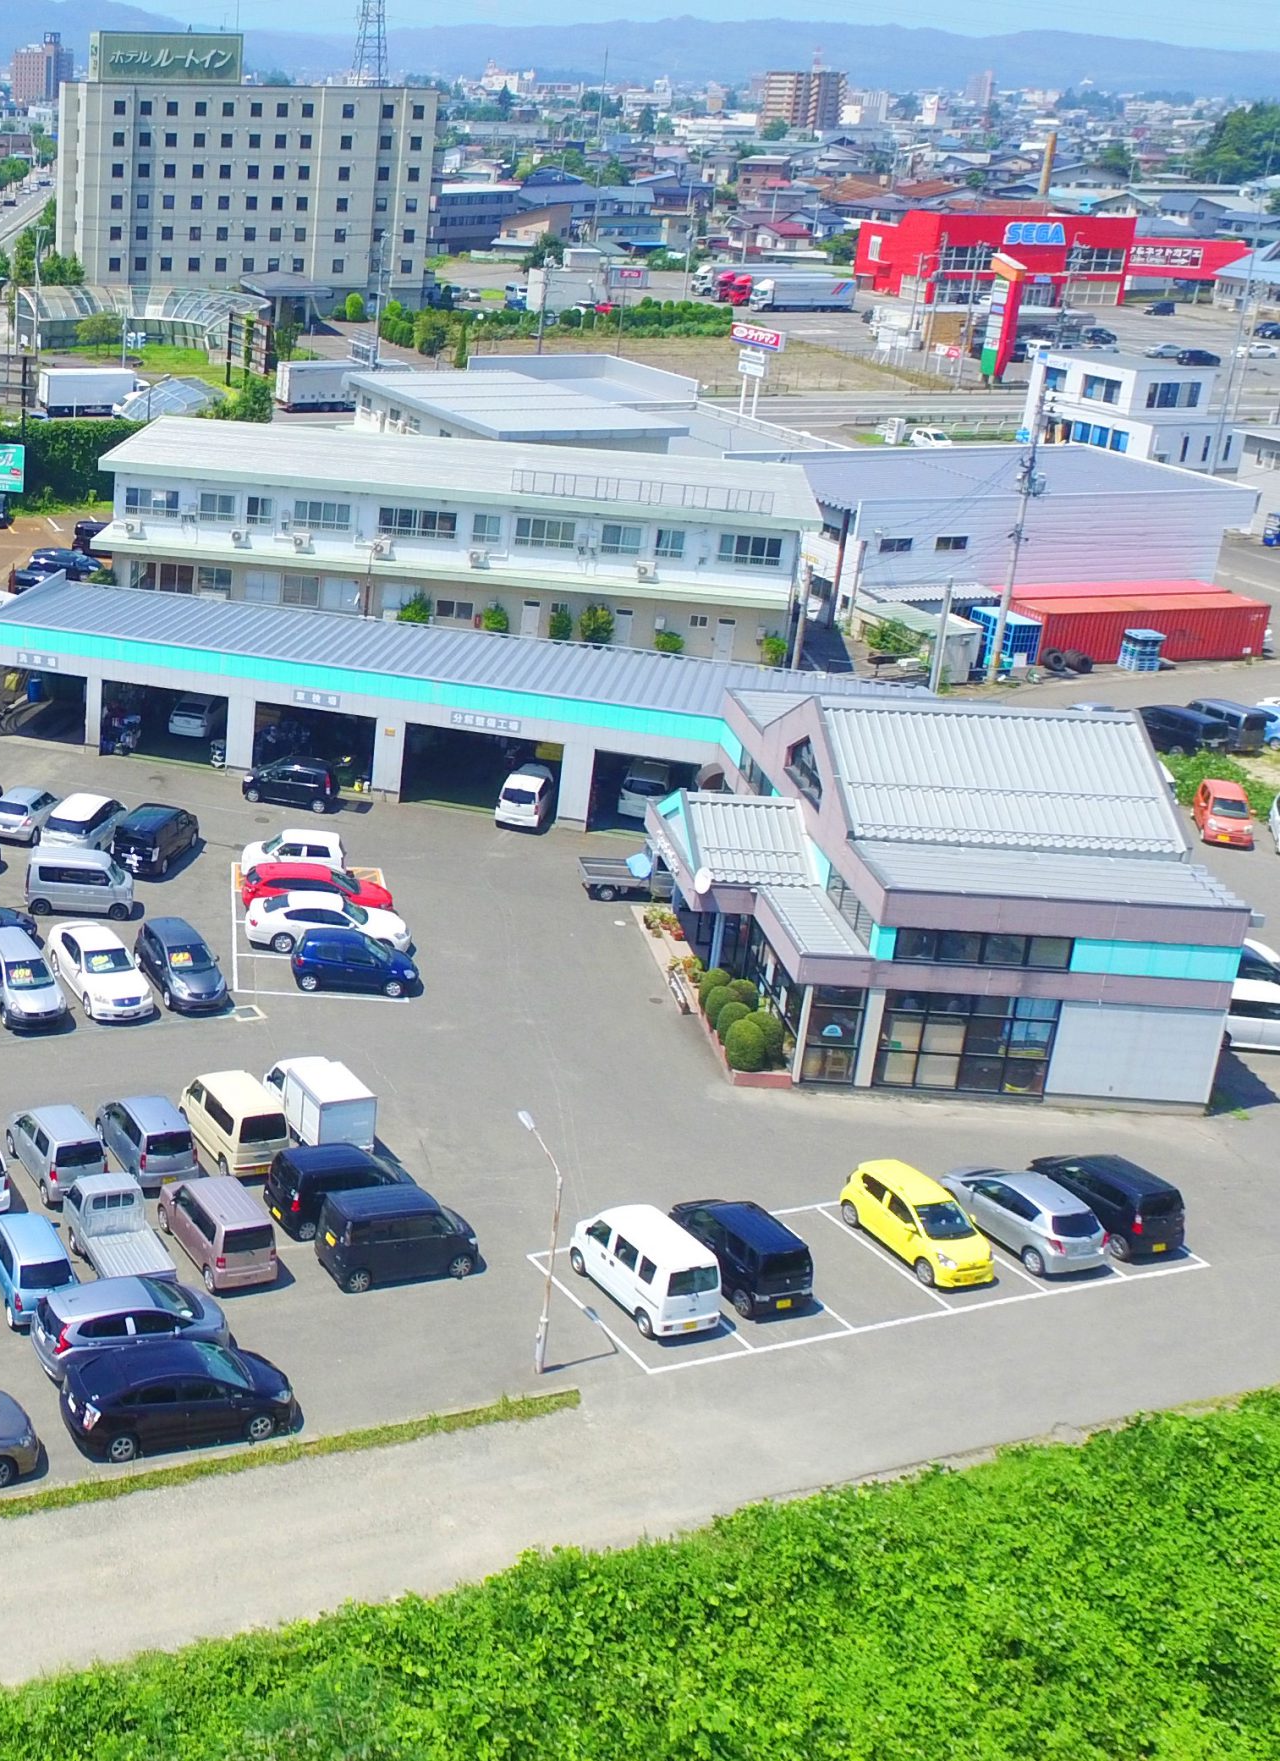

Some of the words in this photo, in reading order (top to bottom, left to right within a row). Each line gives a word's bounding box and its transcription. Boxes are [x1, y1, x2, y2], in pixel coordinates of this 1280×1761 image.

[109, 50, 152, 64] ホテル
[151, 48, 232, 69] ルートイン
[1005, 223, 1065, 244] SEGA
